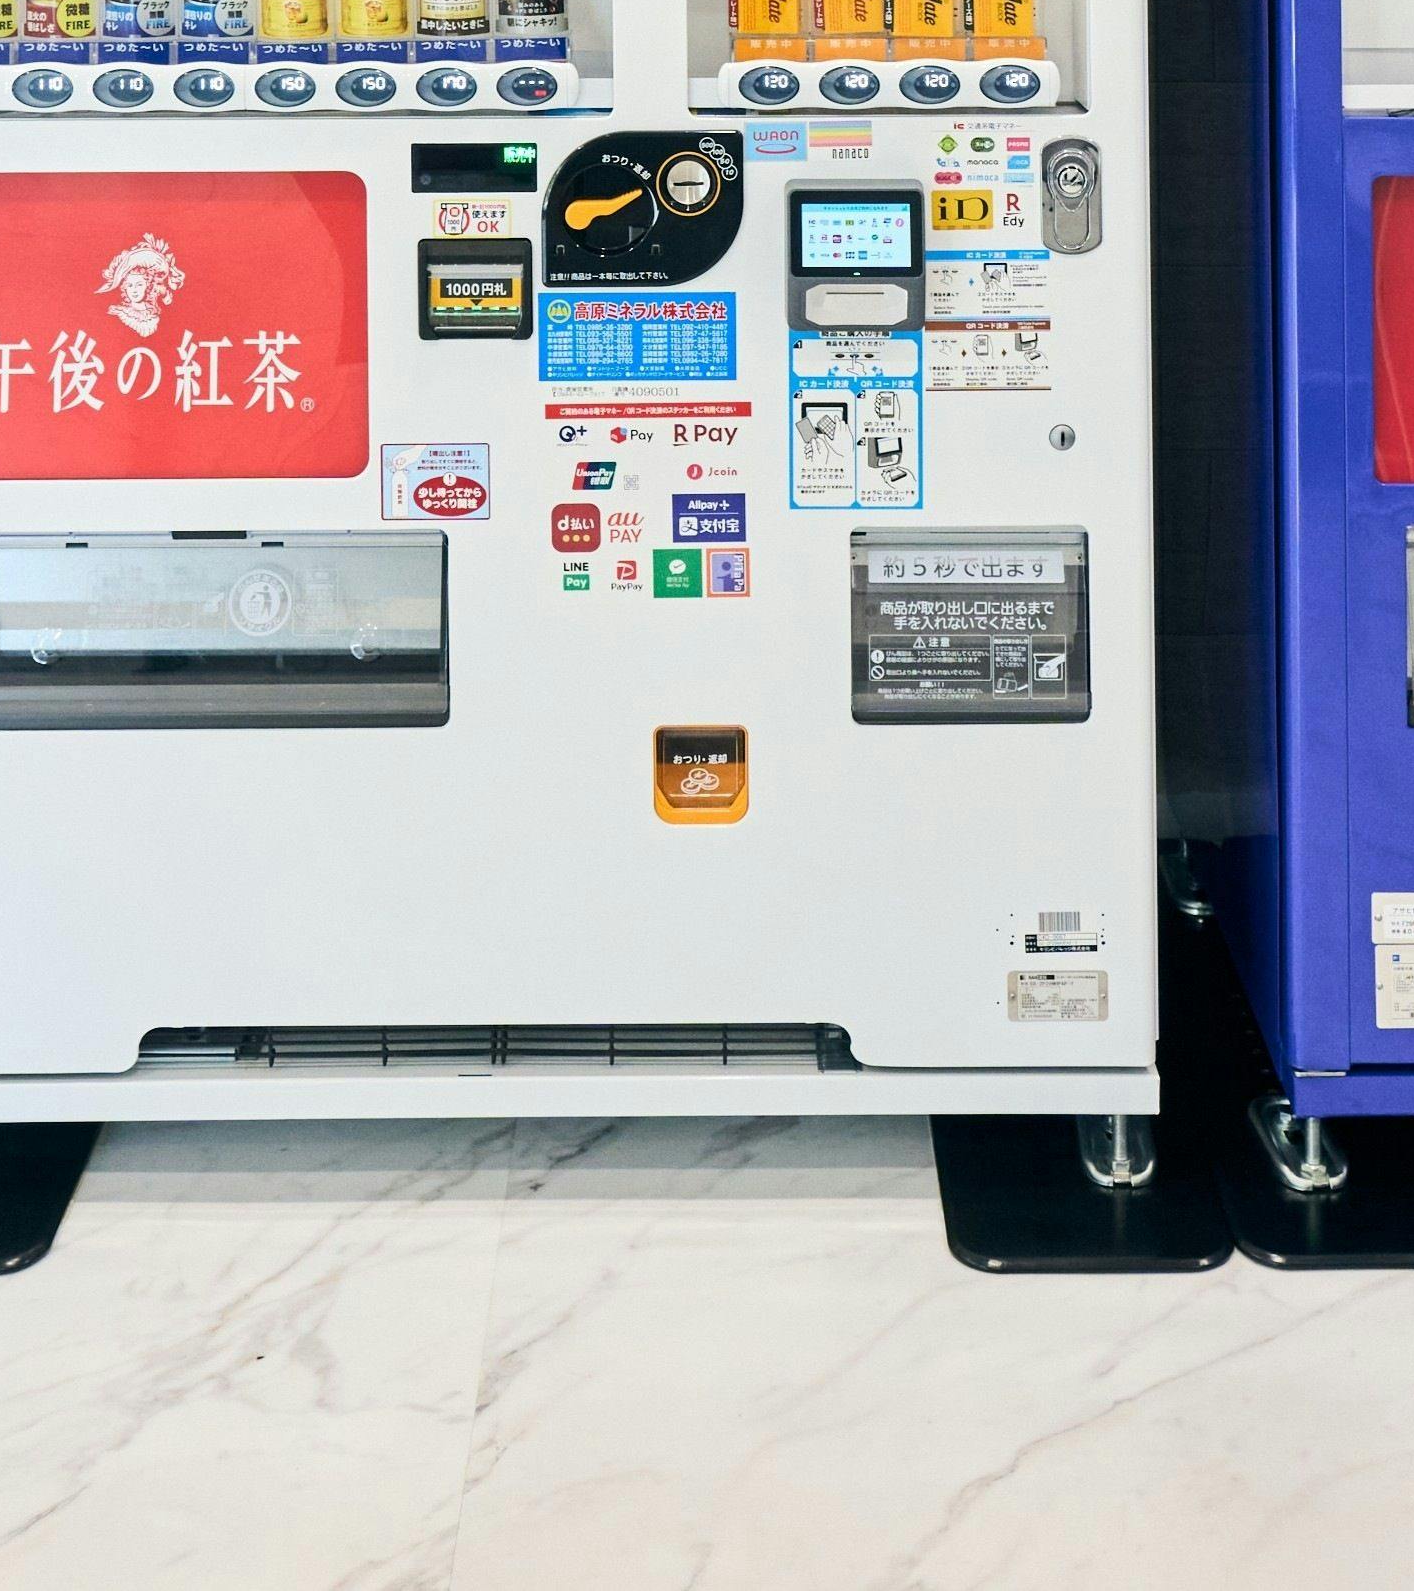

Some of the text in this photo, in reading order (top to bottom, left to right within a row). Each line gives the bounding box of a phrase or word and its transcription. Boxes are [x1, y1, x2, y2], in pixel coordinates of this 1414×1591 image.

[66, 4, 89, 16] 微糖
[66, 20, 90, 31] FIRE
[146, 19, 170, 28] FIRE
[224, 19, 248, 28] FIRE
[764, 74, 788, 88] 120
[473, 210, 506, 218] 使えます
[938, 197, 988, 221] iD
[477, 221, 498, 232] OK
[1003, 216, 1025, 227] Edy
[446, 284, 506, 296] 1000円札
[574, 302, 727, 320] 高原ミネラル株式会社
[631, 430, 653, 442] Pay
[694, 426, 737, 446] Pay
[559, 516, 594, 531] d払い
[608, 511, 644, 526] au
[700, 518, 740, 533] 支付宝
[610, 529, 642, 543] PAY
[563, 562, 588, 571] LINE
[566, 577, 586, 587] Pay
[611, 583, 643, 592] PayPay
[880, 601, 1054, 616] 商品が取り出し口に出るまで
[929, 637, 950, 647] 注意
